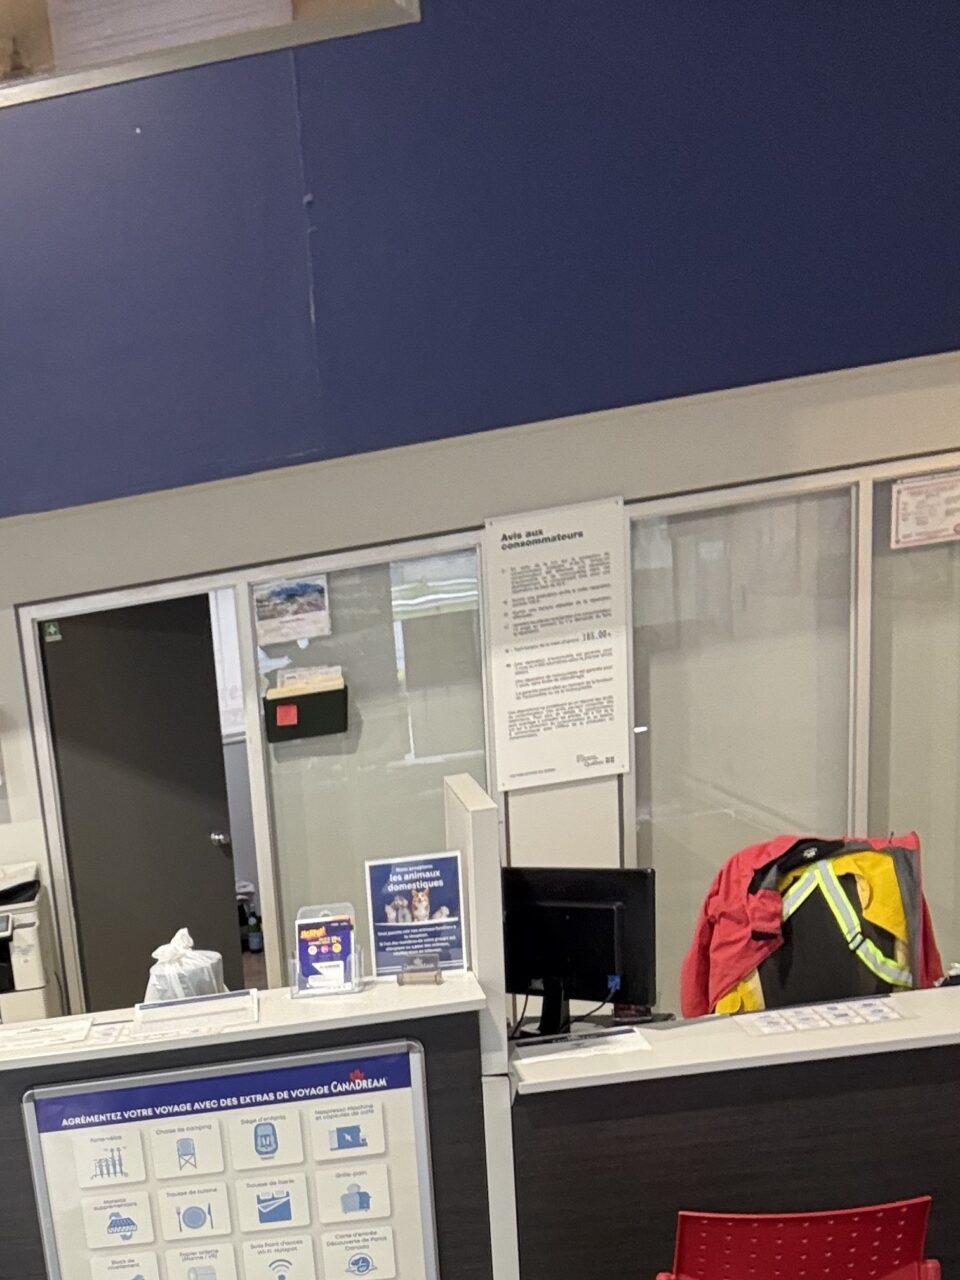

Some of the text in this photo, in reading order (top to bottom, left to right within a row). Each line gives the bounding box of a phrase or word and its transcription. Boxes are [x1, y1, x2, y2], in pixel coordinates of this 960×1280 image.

[501, 529, 543, 541] Avis aux
[501, 530, 584, 551] consommateurs
[389, 870, 441, 882] les animaux
[387, 879, 444, 892] domestiques
[61, 1077, 387, 1127] AGRÉMENTEZ VOTRE VOYAGE AVEC DES EXTRAS DE VOYAGE CANADREAM
